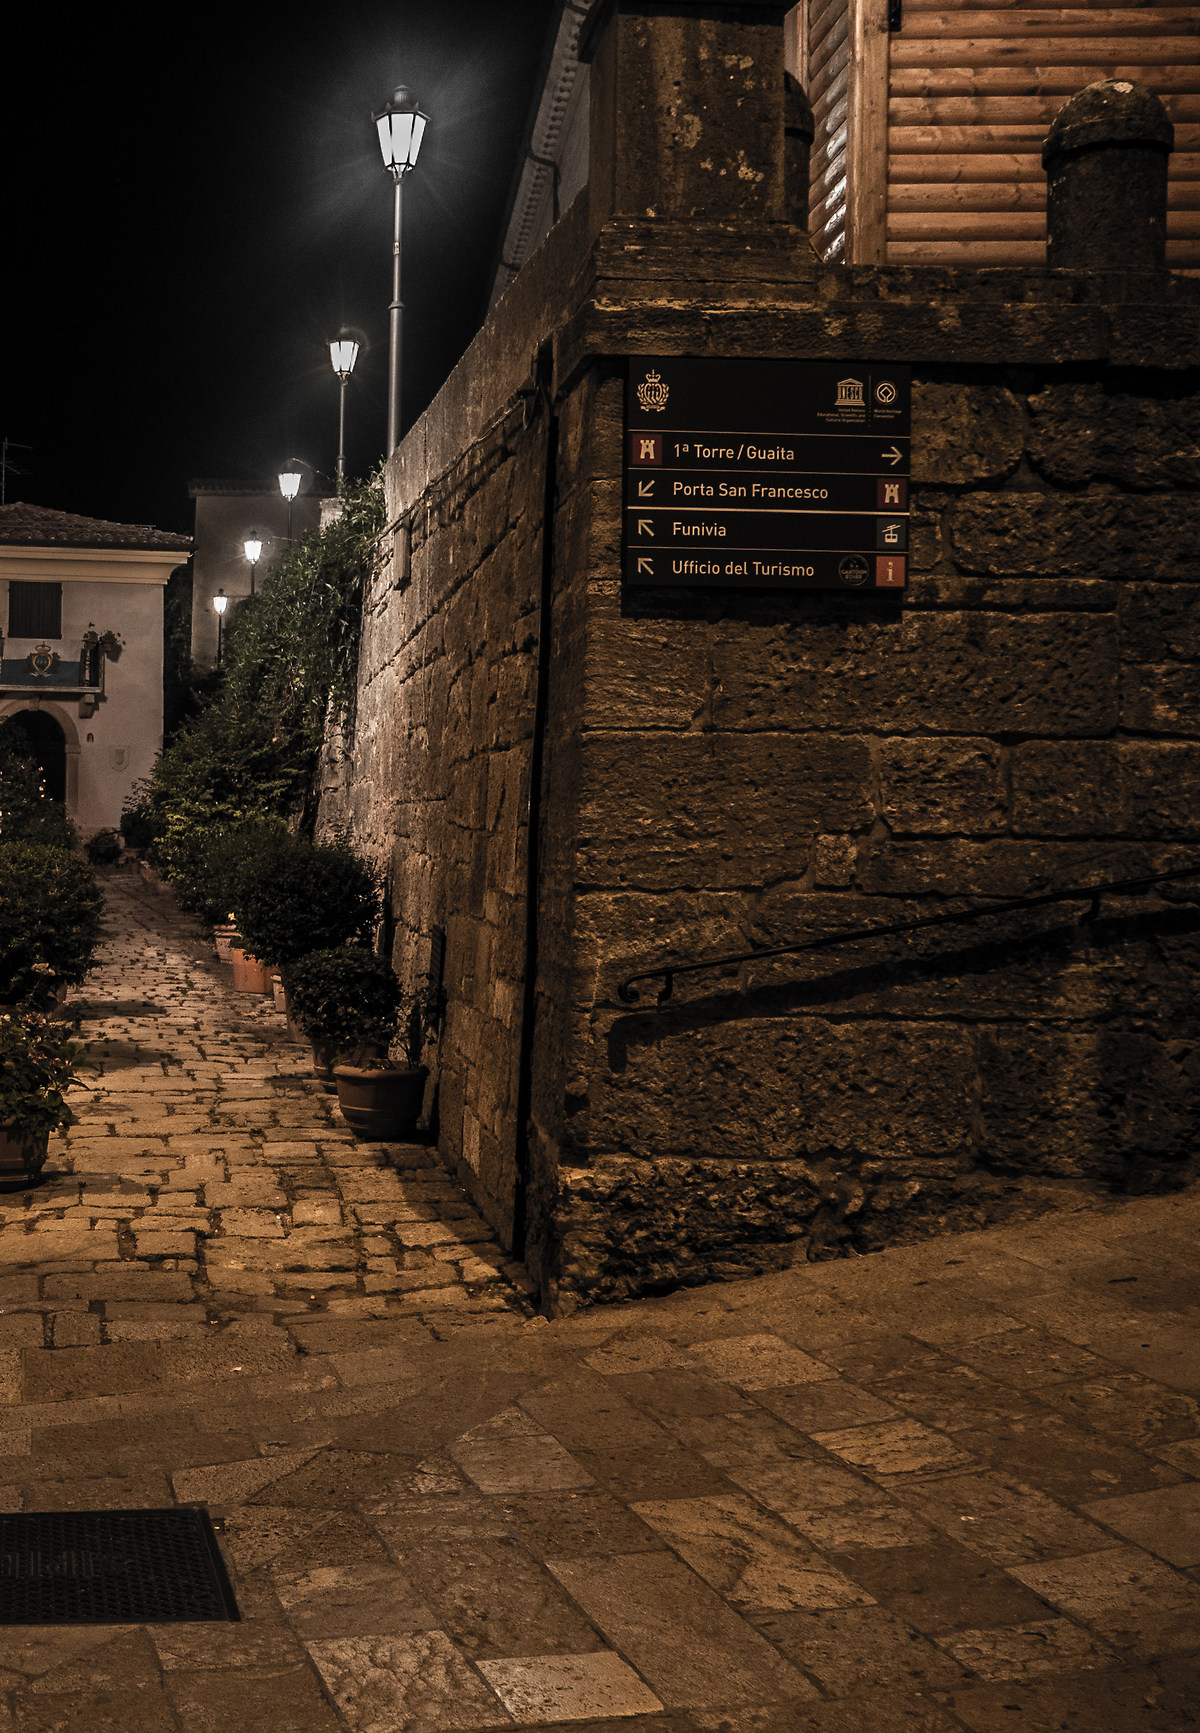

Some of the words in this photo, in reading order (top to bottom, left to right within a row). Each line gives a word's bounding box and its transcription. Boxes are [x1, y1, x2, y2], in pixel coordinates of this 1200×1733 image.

[673, 481, 714, 497] Porta
[719, 482, 747, 497] San
[751, 483, 829, 500] Francesco
[672, 521, 727, 537] Funivia
[672, 560, 721, 575] Ufficio
[724, 561, 749, 576] del
[752, 561, 815, 577] Turismo
